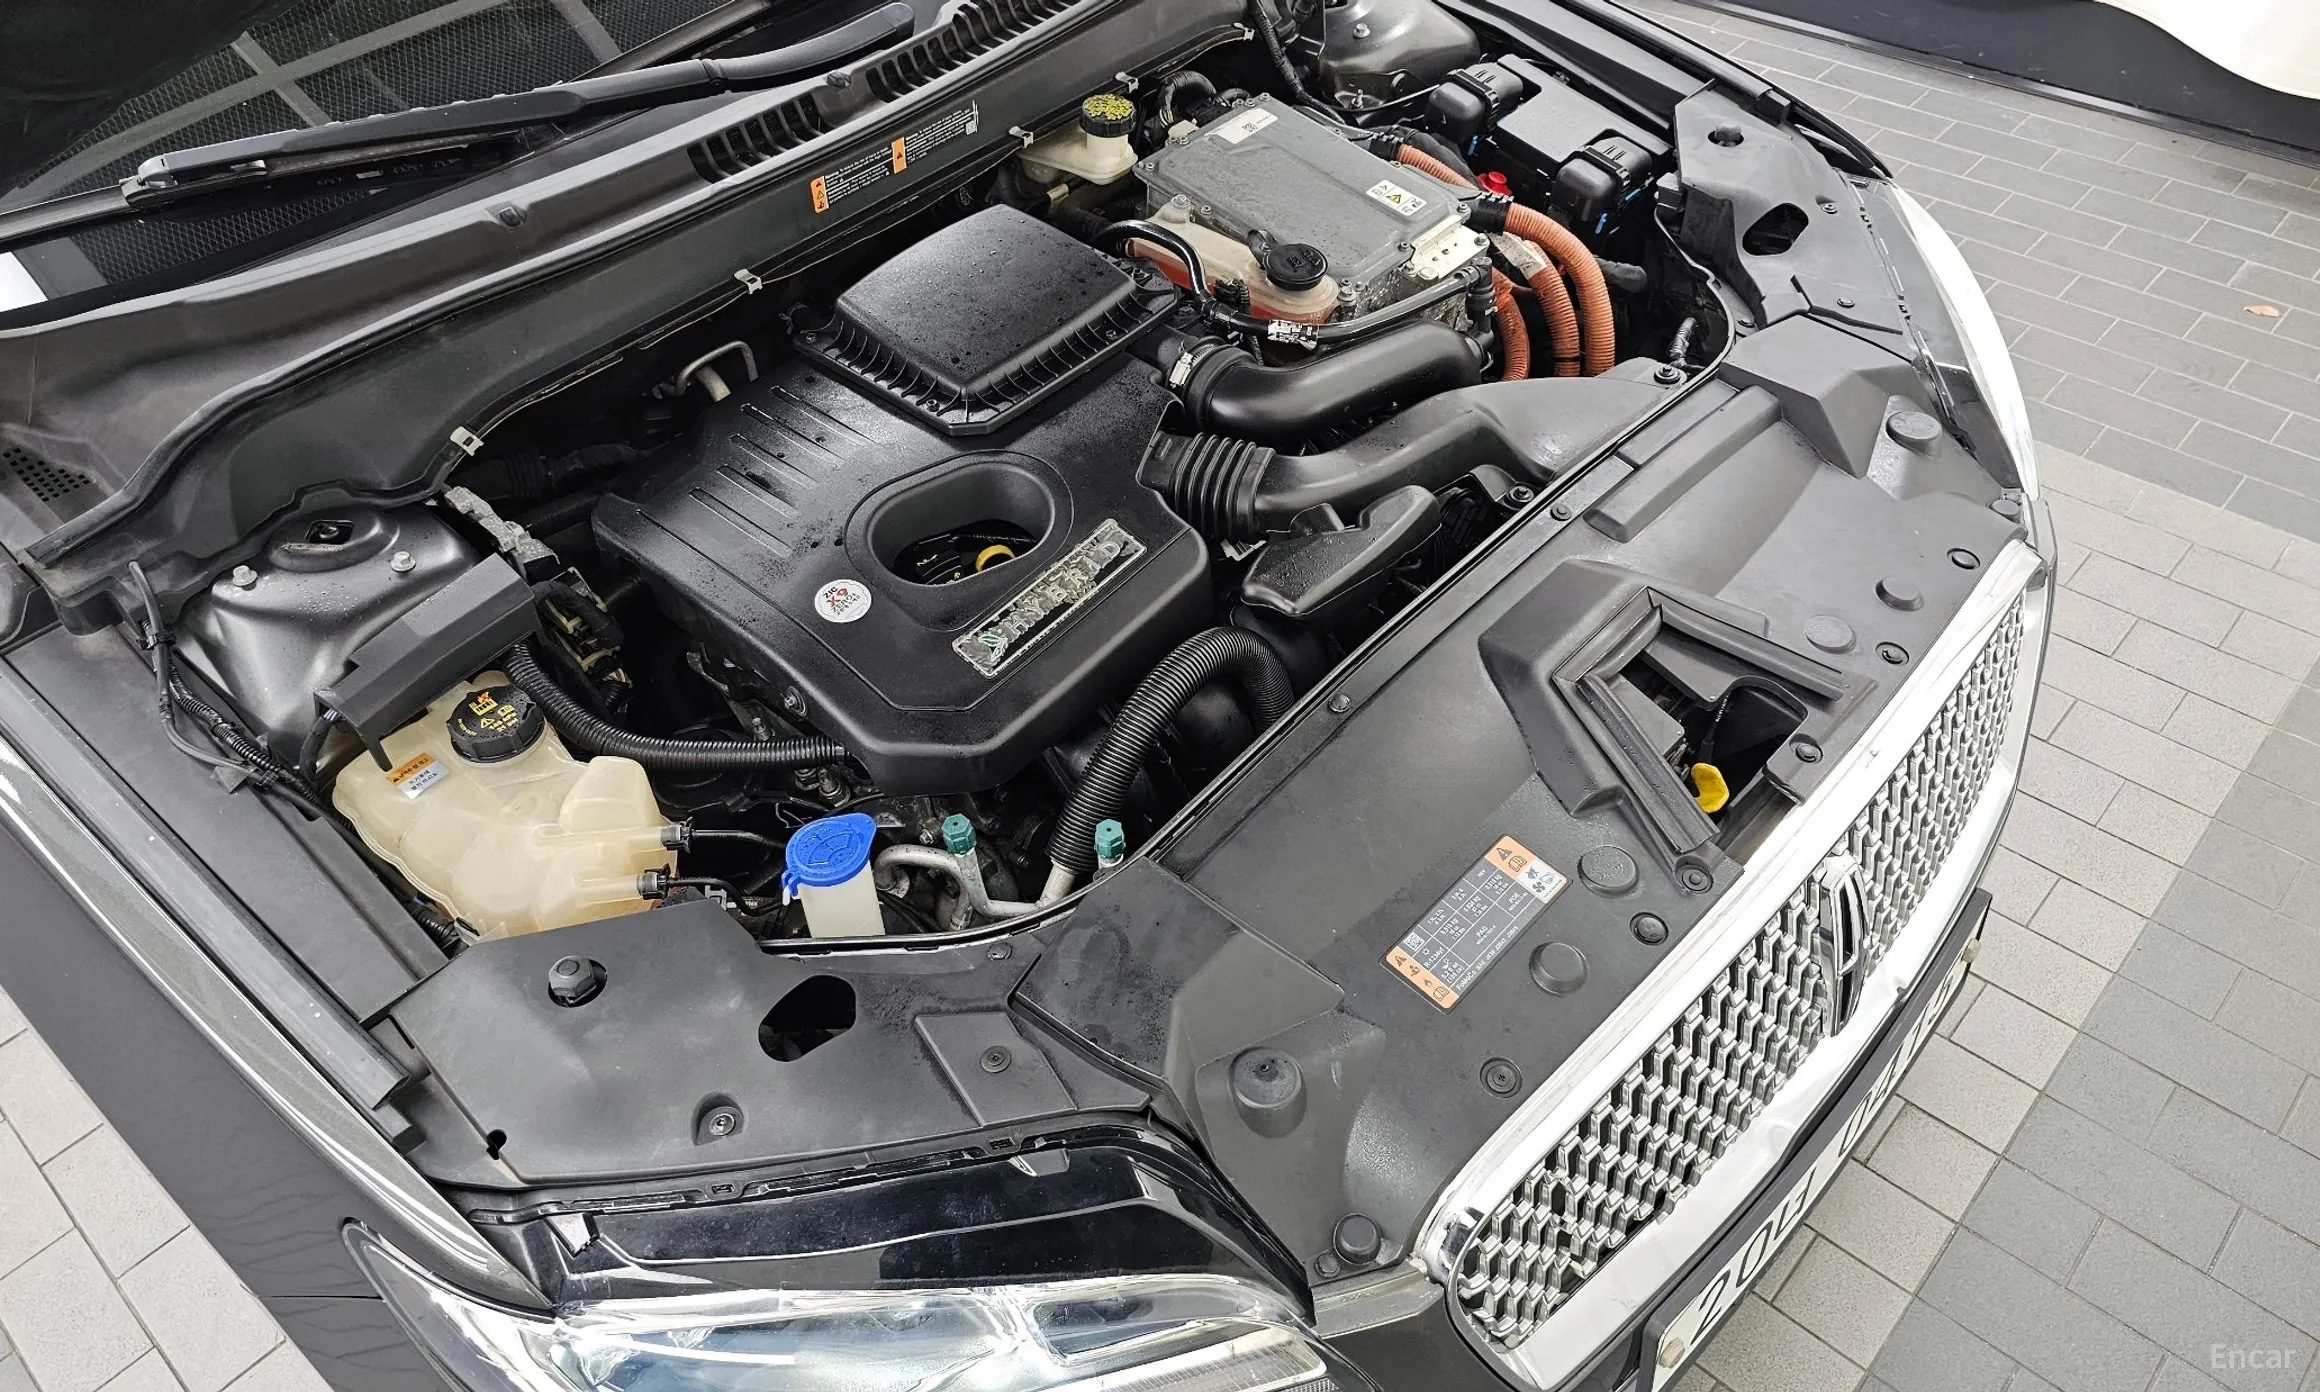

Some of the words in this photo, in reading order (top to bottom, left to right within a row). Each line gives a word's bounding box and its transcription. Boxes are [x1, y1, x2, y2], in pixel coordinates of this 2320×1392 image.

[1007, 539, 1122, 637] HYBRID
[1456, 969, 1477, 991] FoMoCo
[1690, 1165, 1817, 1345] 20너
